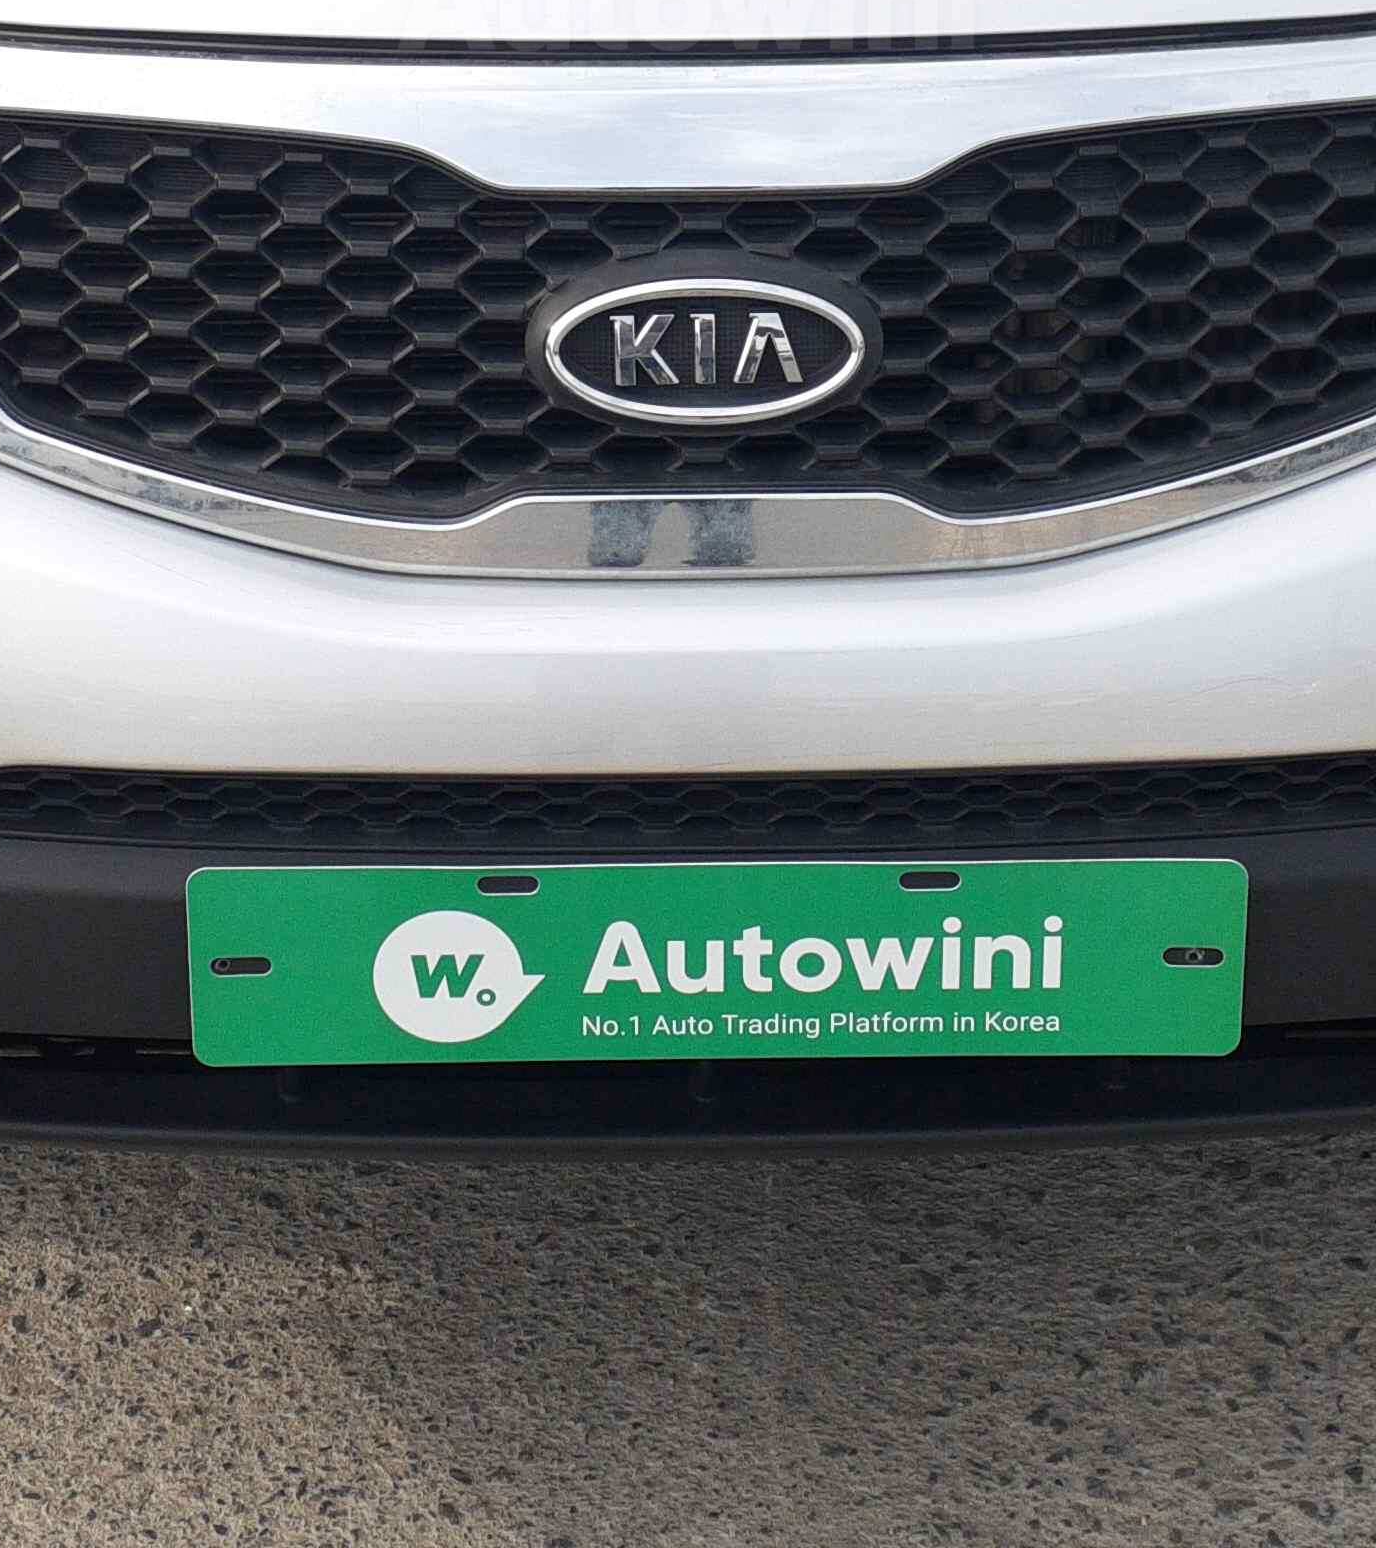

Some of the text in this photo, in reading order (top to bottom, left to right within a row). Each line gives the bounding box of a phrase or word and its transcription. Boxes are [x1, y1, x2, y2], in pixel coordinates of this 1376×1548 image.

[609, 312, 804, 387] KIA
[582, 914, 1064, 995] Autowini
[581, 1010, 1062, 1040] No.1 Auto Trading Platform in Korea
